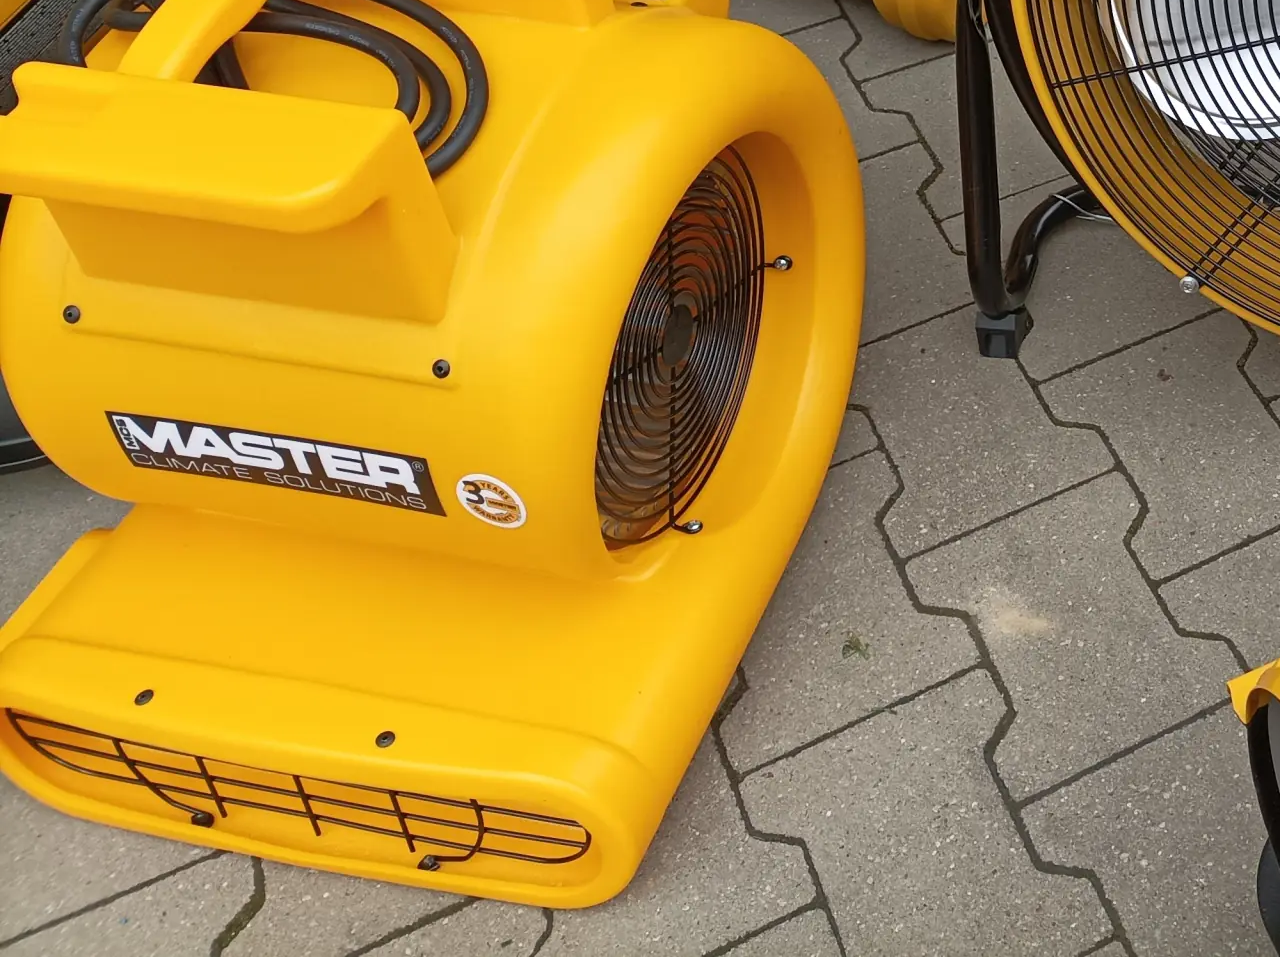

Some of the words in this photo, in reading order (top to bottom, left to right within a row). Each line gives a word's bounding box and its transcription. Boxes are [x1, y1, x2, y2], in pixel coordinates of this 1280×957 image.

[114, 417, 139, 450] MCS
[124, 417, 421, 495] MASTER
[130, 453, 250, 481] CLIMATE
[263, 471, 428, 510] SOLUTIONS
[462, 480, 485, 505] 3
[480, 482, 509, 500] YEARS
